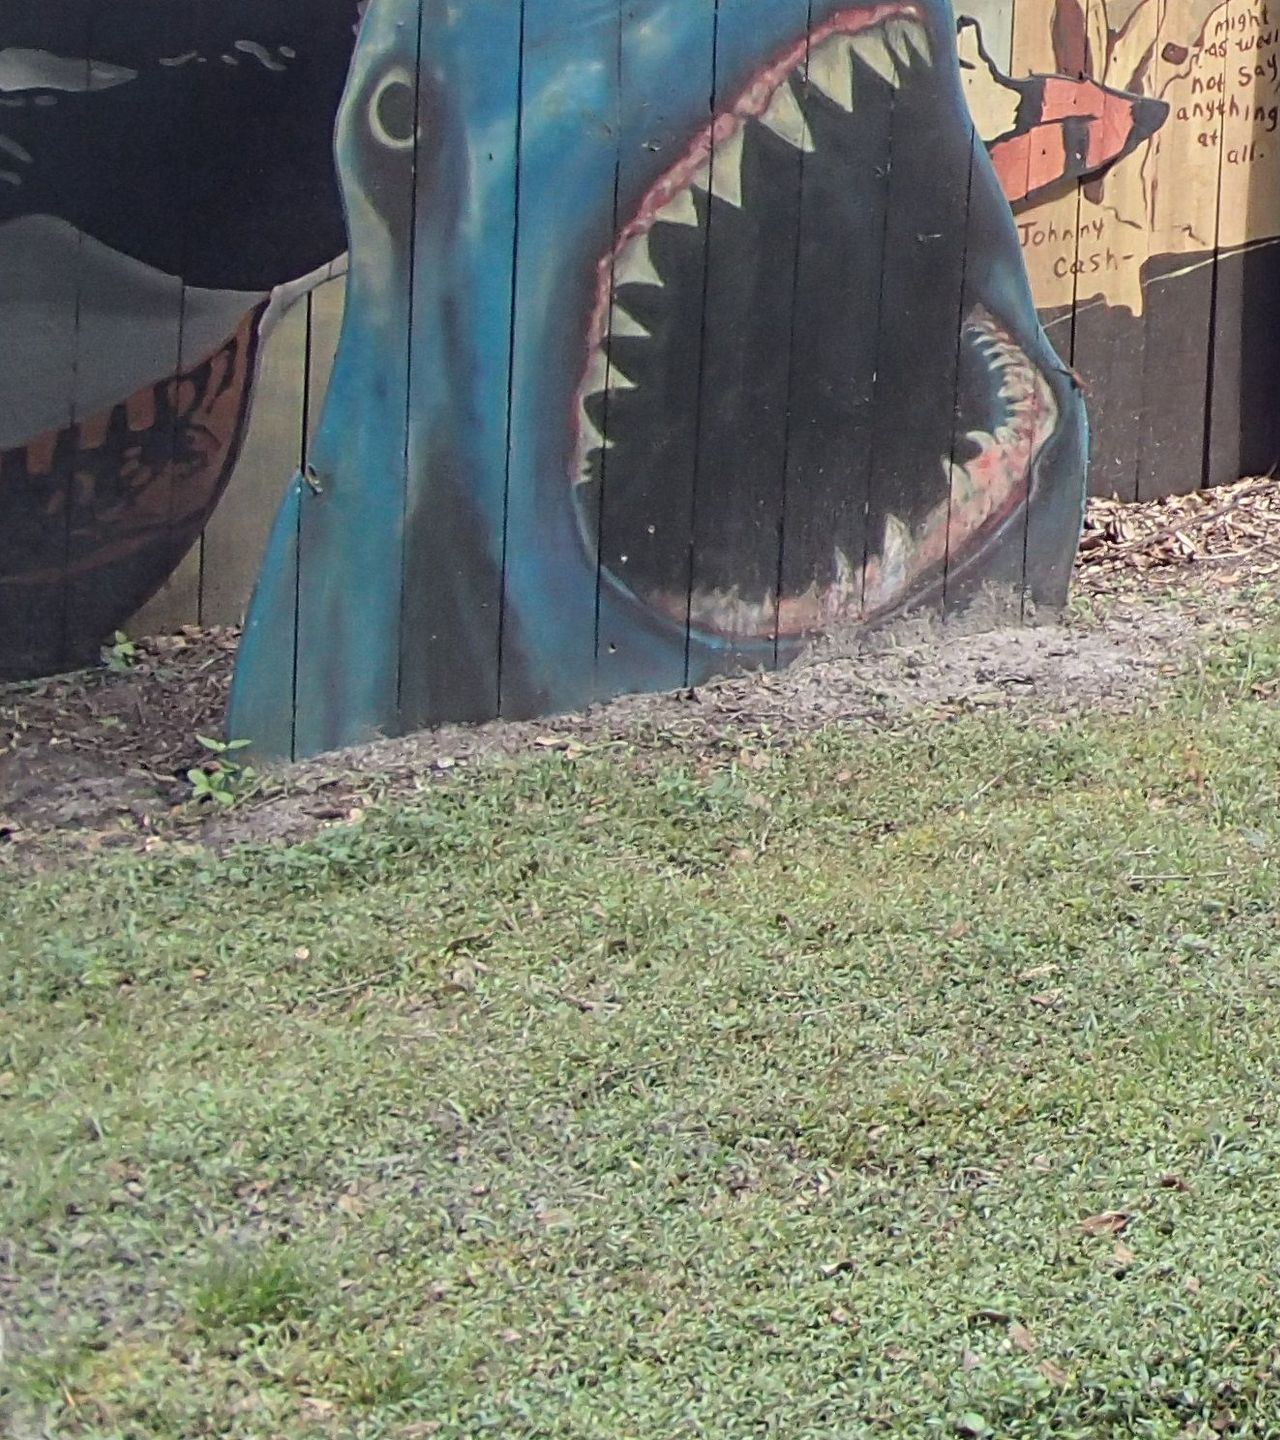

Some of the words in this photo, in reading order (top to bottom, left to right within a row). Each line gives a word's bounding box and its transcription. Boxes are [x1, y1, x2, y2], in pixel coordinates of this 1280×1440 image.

[1214, 9, 1270, 37] might
[1236, 28, 1280, 53] well
[1191, 73, 1225, 95] not
[1176, 93, 1279, 133] anything
[1197, 129, 1218, 148] at
[1017, 218, 1105, 248] Johnny
